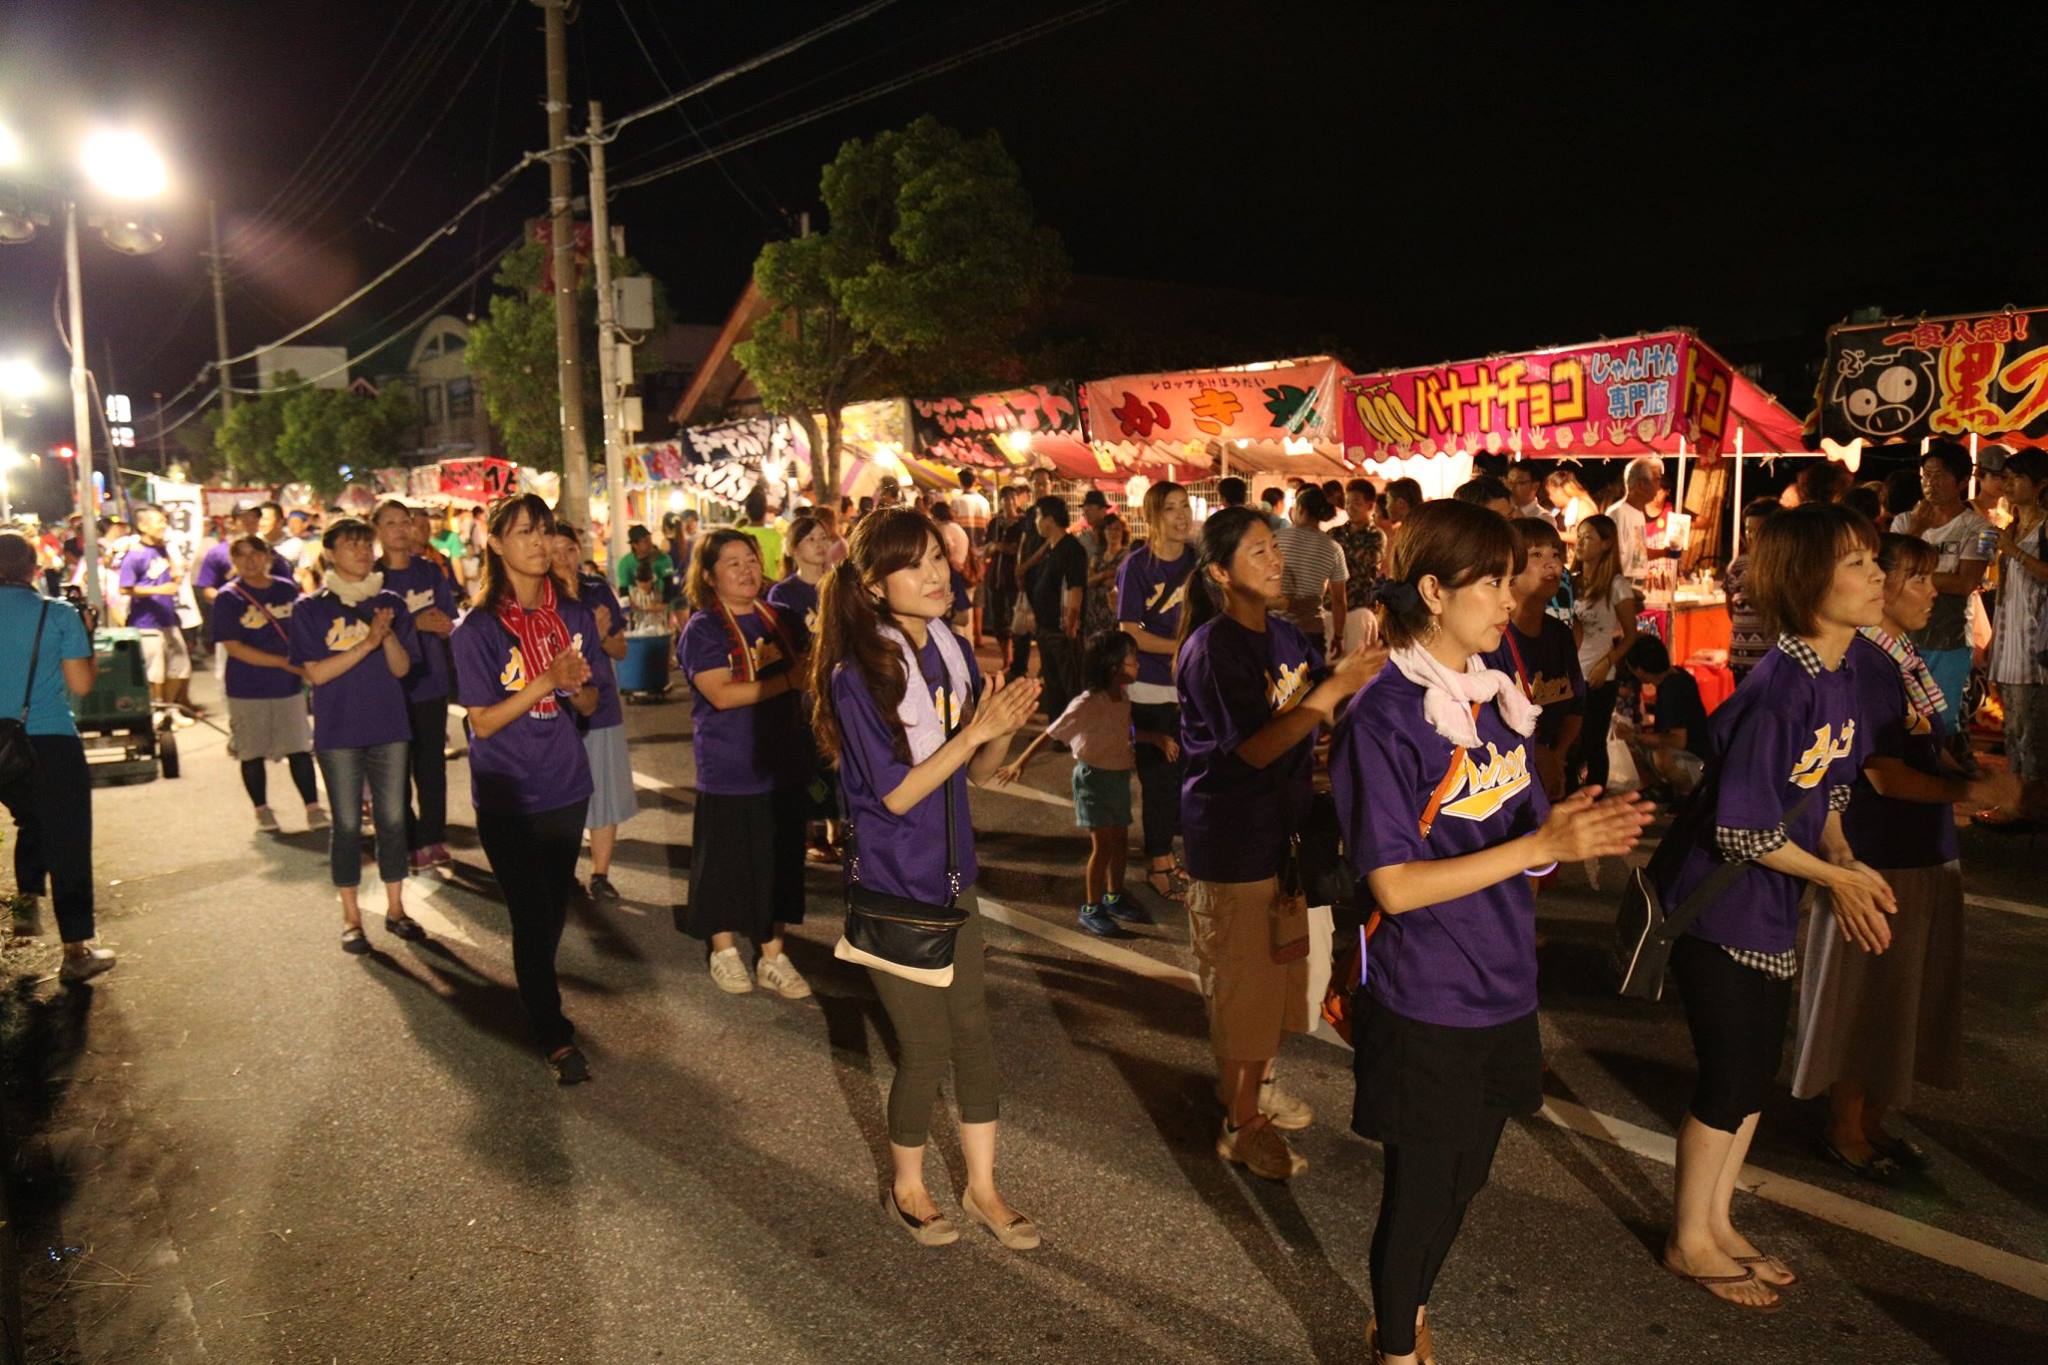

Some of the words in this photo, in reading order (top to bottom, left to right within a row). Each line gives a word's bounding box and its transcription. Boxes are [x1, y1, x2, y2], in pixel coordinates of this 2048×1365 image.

[1591, 343, 1679, 385] じゃんけん
[1414, 357, 1588, 436] バナナチョコ
[1608, 380, 1670, 419] 専門店
